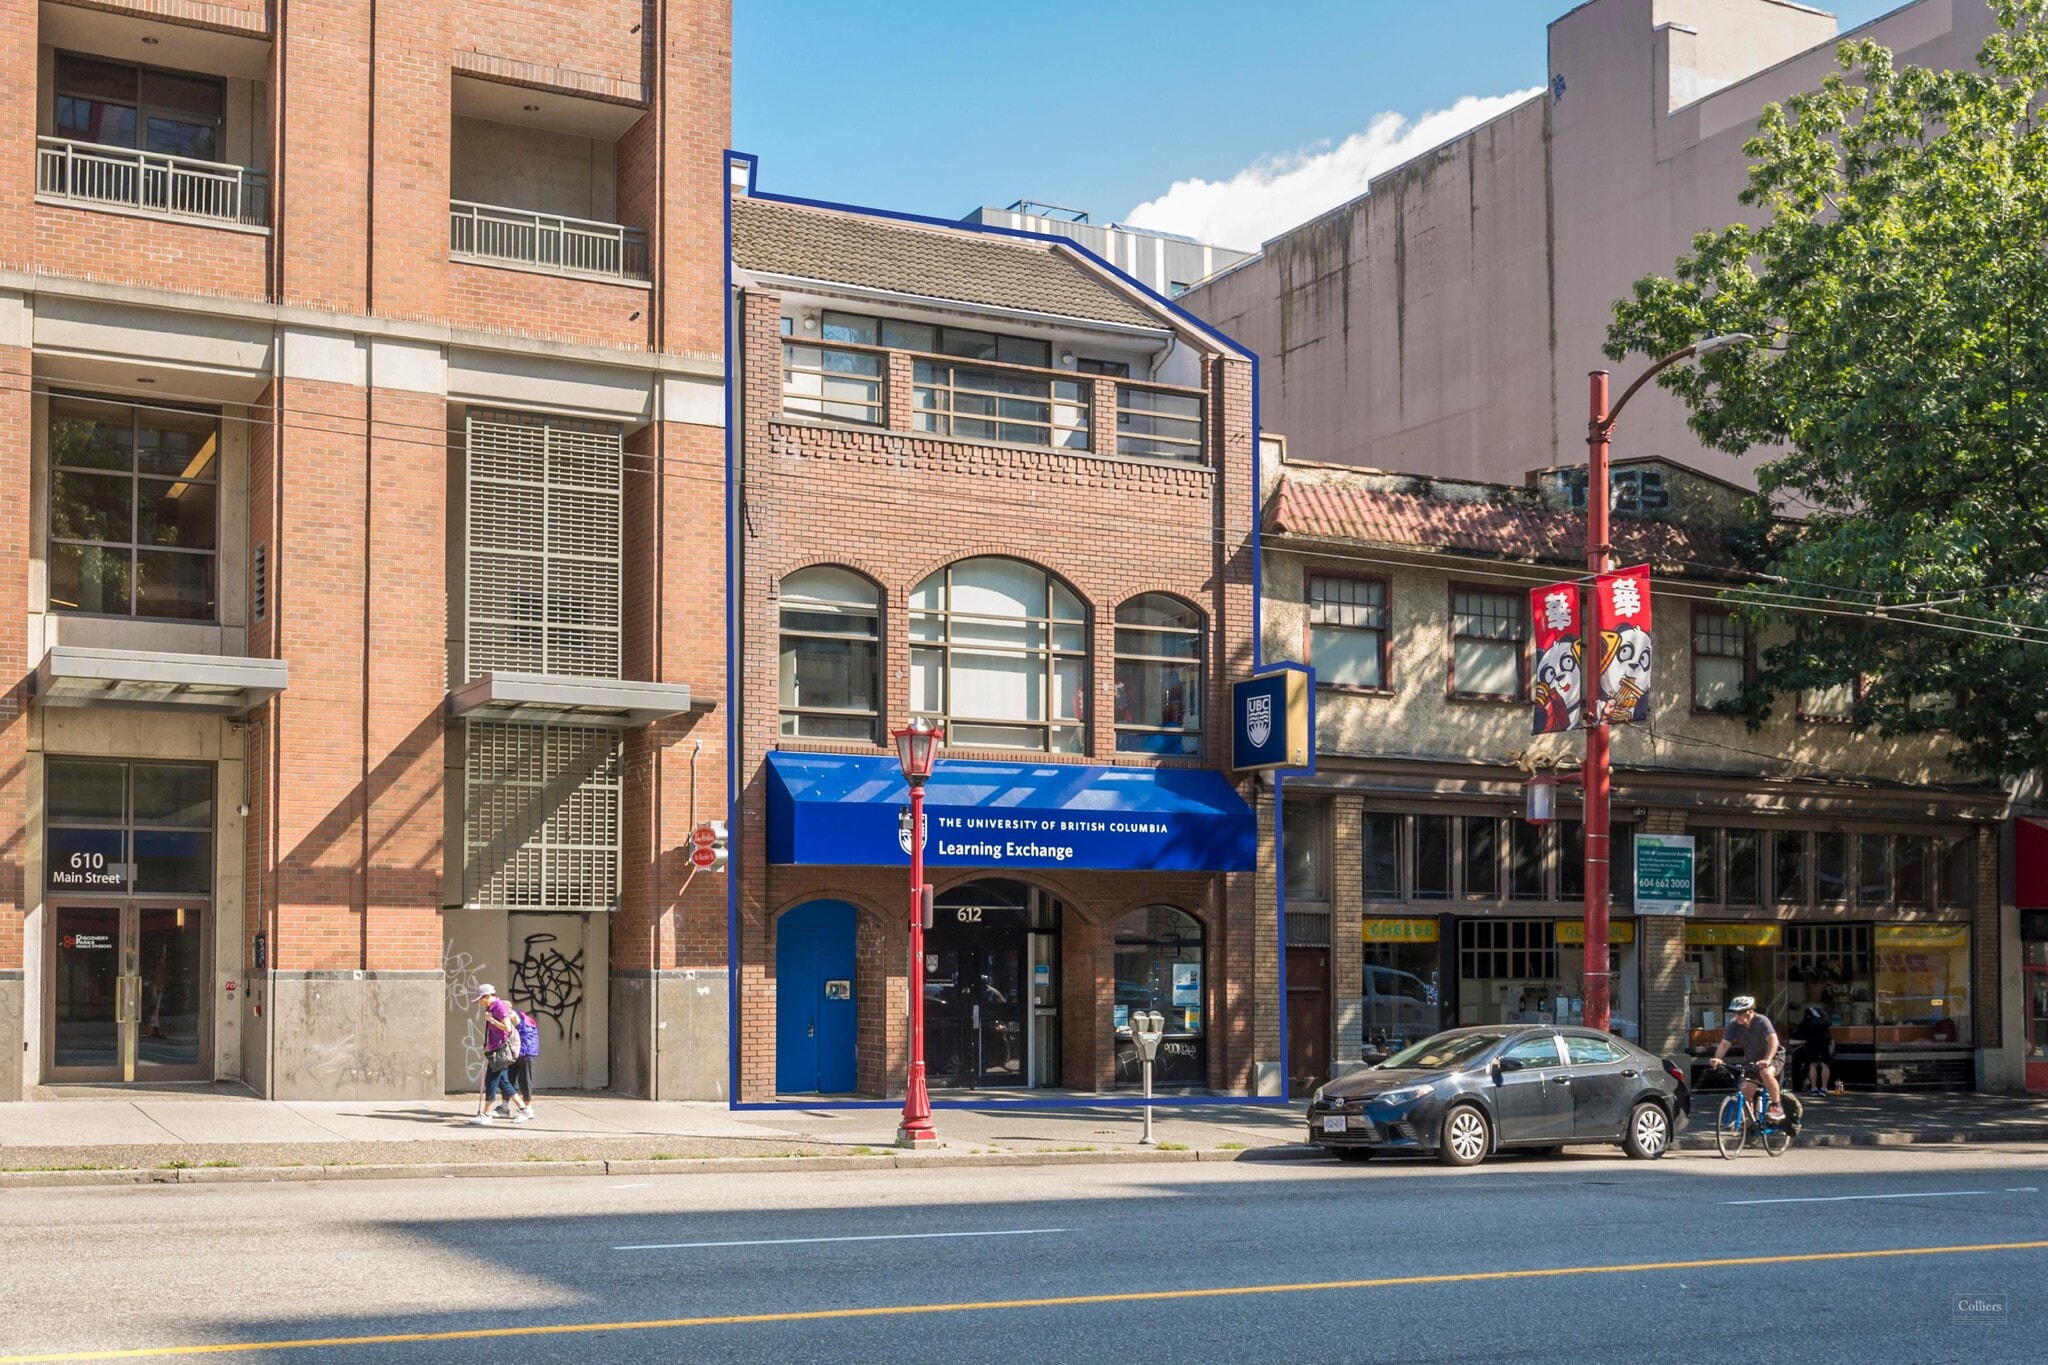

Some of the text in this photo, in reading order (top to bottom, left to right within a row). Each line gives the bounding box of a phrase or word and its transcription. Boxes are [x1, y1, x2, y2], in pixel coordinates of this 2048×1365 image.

[1612, 578, 1641, 618] 華
[1544, 592, 1572, 631] 華
[1249, 698, 1269, 712] UBC
[939, 817, 962, 828] THE
[967, 818, 1037, 830] UNIVERSITY
[1041, 820, 1055, 830] OF
[1060, 820, 1105, 832] BRITISH
[1109, 822, 1168, 834] COLUMBIA
[938, 840, 1073, 861] Learning Exchange
[70, 852, 104, 869] 610
[53, 871, 121, 884] Main Street
[1639, 878, 1690, 889] 604 662 3000
[957, 907, 982, 922] 612
[1370, 924, 1433, 937] CHEESE
